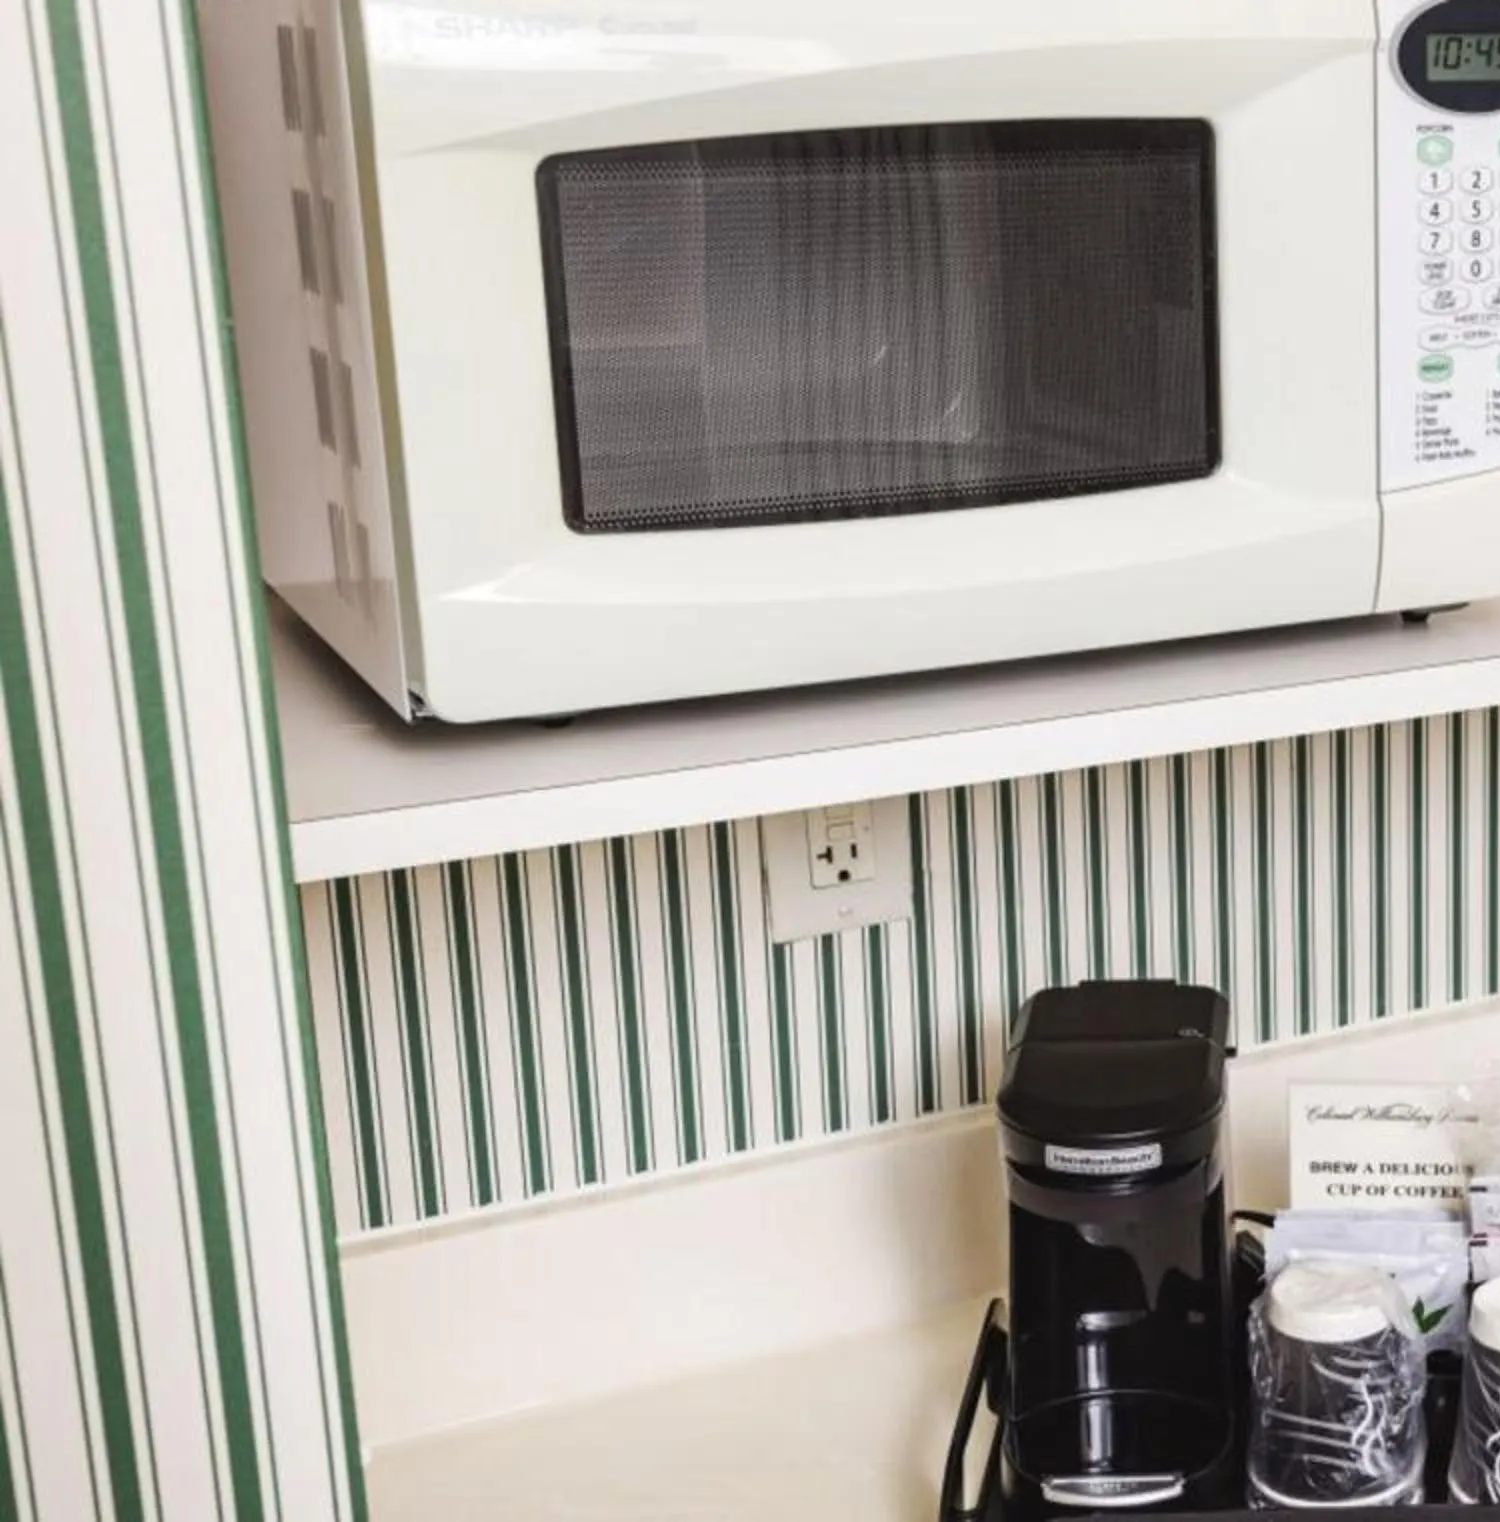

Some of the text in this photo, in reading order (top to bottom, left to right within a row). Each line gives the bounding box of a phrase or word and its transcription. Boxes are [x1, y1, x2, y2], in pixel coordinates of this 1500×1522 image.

[1430, 172, 1438, 189] 1
[1471, 170, 1481, 190] 2
[1429, 202, 1440, 219] 4
[1471, 199, 1481, 219] 5
[1429, 231, 1440, 249] 7
[1471, 229, 1481, 248] 8
[1470, 259, 1481, 278] 0
[1309, 1161, 1358, 1174] BREW
[1363, 1163, 1375, 1174] A
[1326, 1183, 1362, 1196] CUP
[1365, 1184, 1389, 1197] OF
